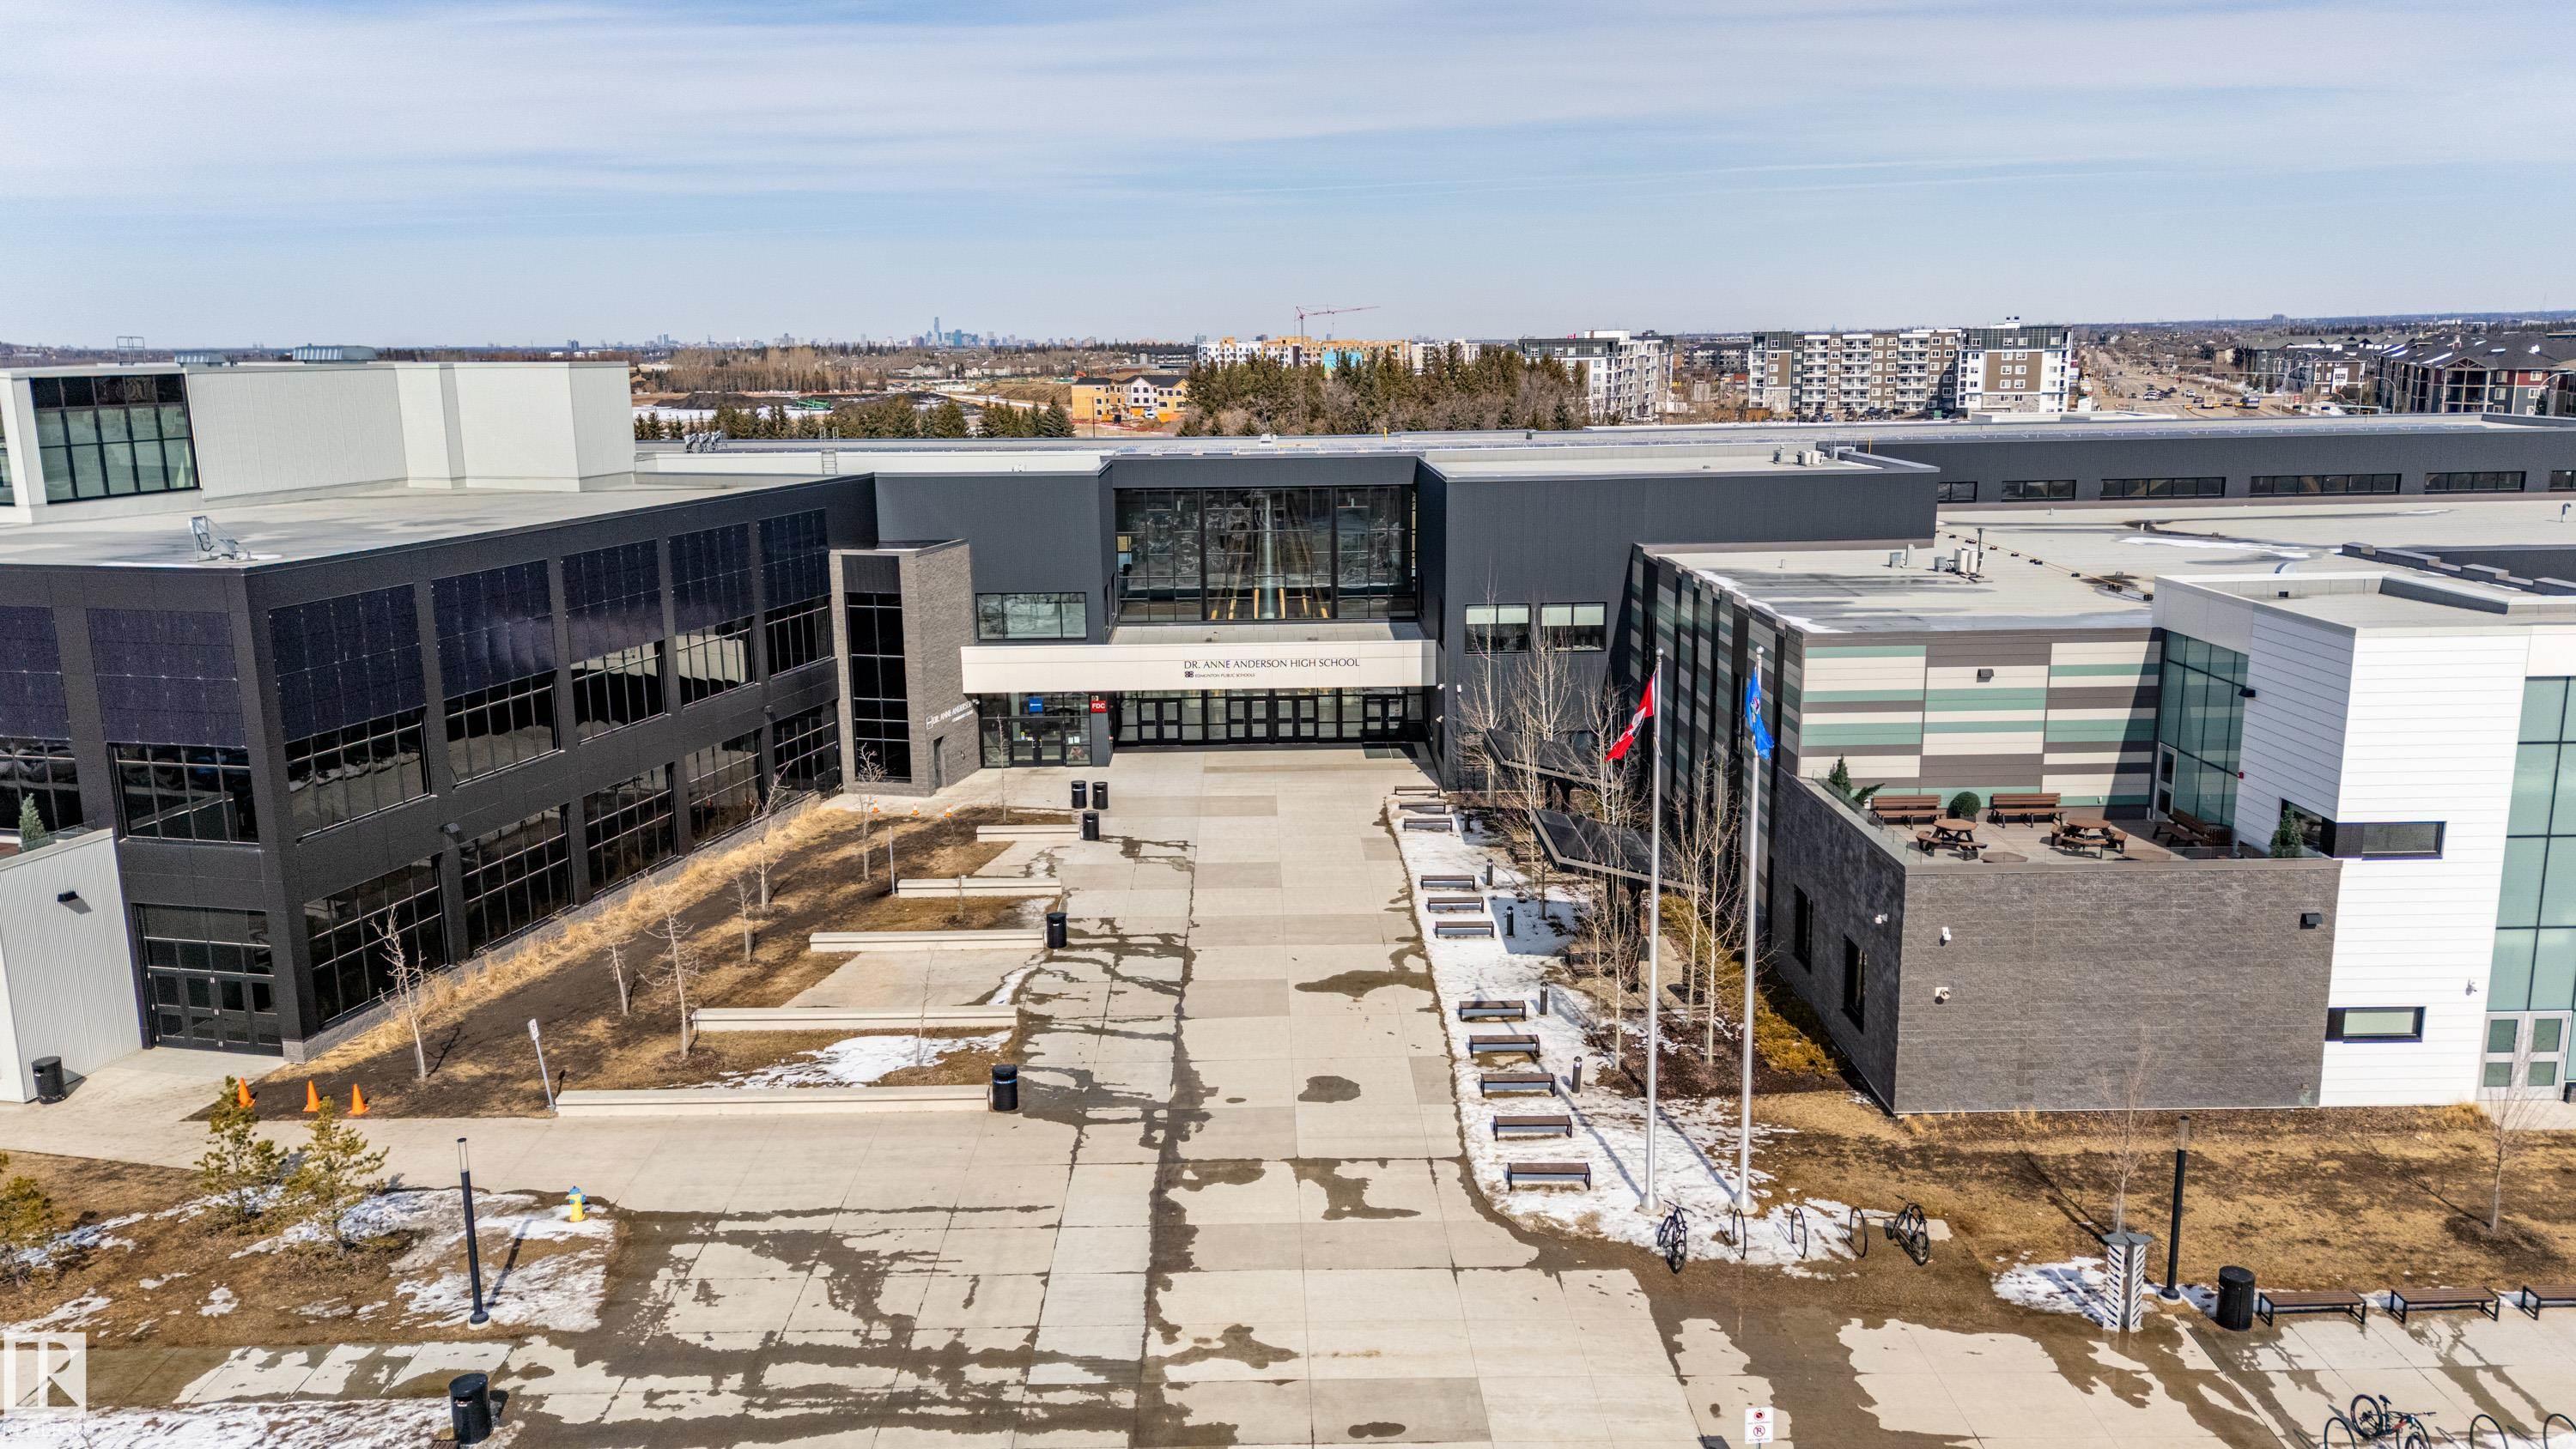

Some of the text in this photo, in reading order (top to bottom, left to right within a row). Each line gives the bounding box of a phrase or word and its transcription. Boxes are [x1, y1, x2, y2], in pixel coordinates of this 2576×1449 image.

[1184, 658, 1360, 669] DR. ANNE ANDERSON HIGH SCHOOL
